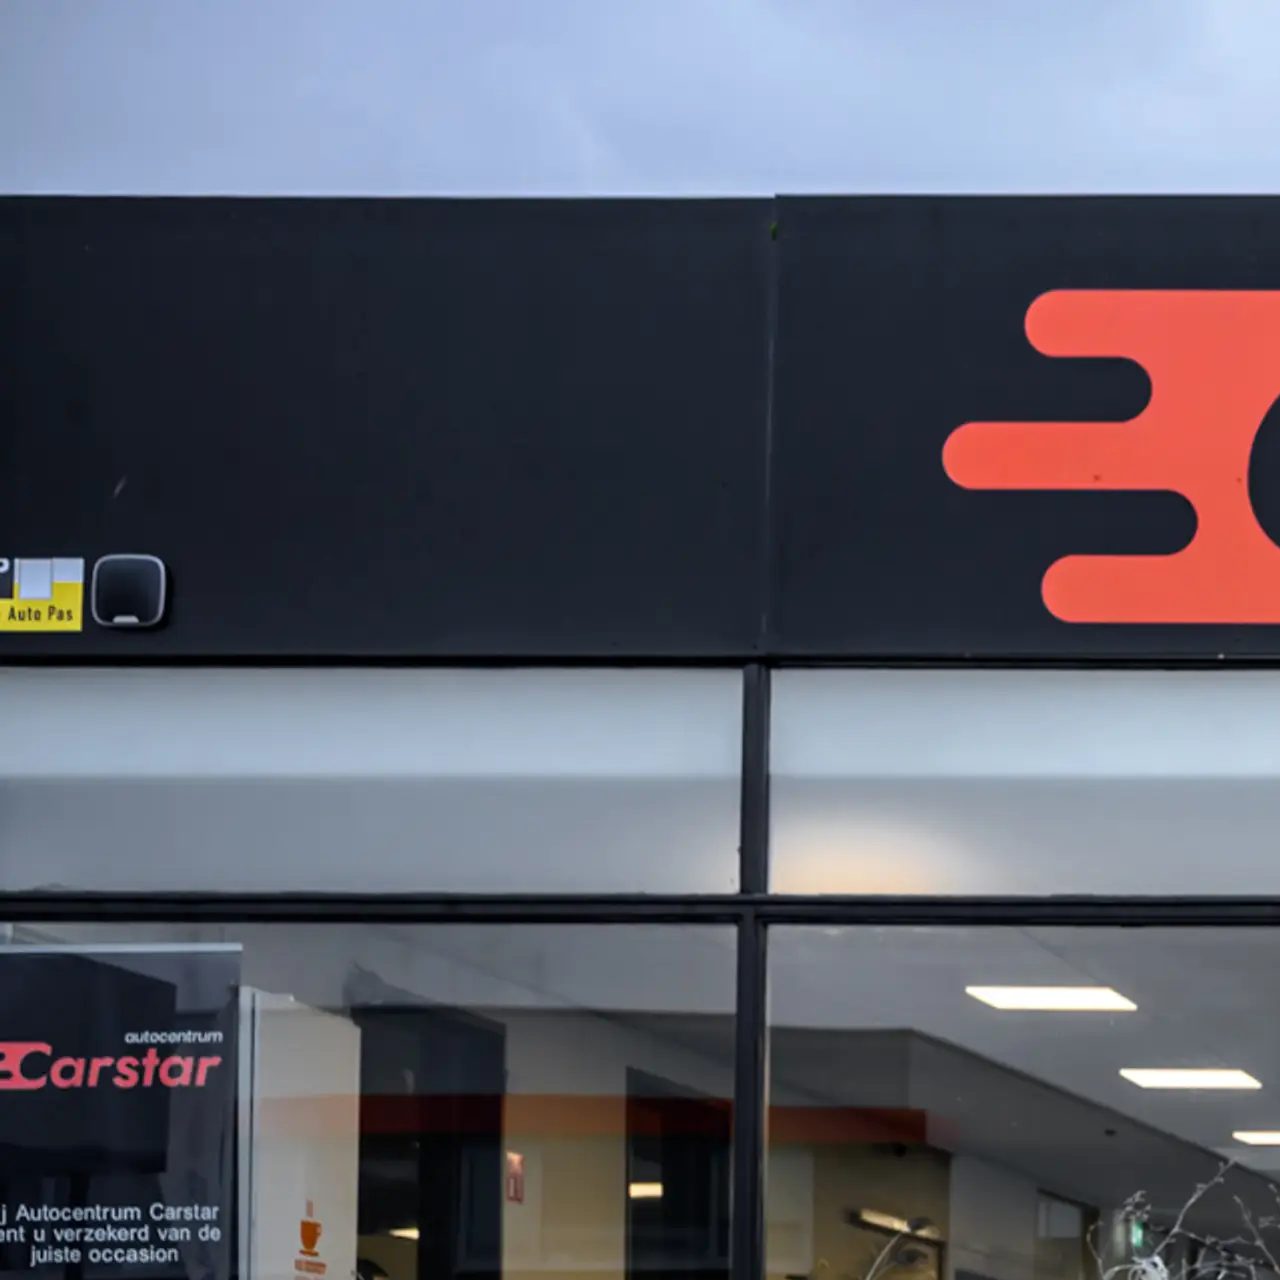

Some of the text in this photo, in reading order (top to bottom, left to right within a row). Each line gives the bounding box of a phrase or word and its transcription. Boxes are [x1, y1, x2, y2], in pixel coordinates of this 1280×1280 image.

[8, 605, 73, 621] Auto Pas
[125, 1030, 223, 1044] autocentrum
[0, 1041, 222, 1090] Carstar
[15, 1203, 141, 1221] Autocentrum
[150, 1203, 219, 1221] Carstar
[33, 1229, 46, 1242] u
[53, 1224, 149, 1242] verzekerd
[158, 1229, 190, 1242] van
[199, 1224, 221, 1242] de
[30, 1245, 178, 1267] juiste occasion
